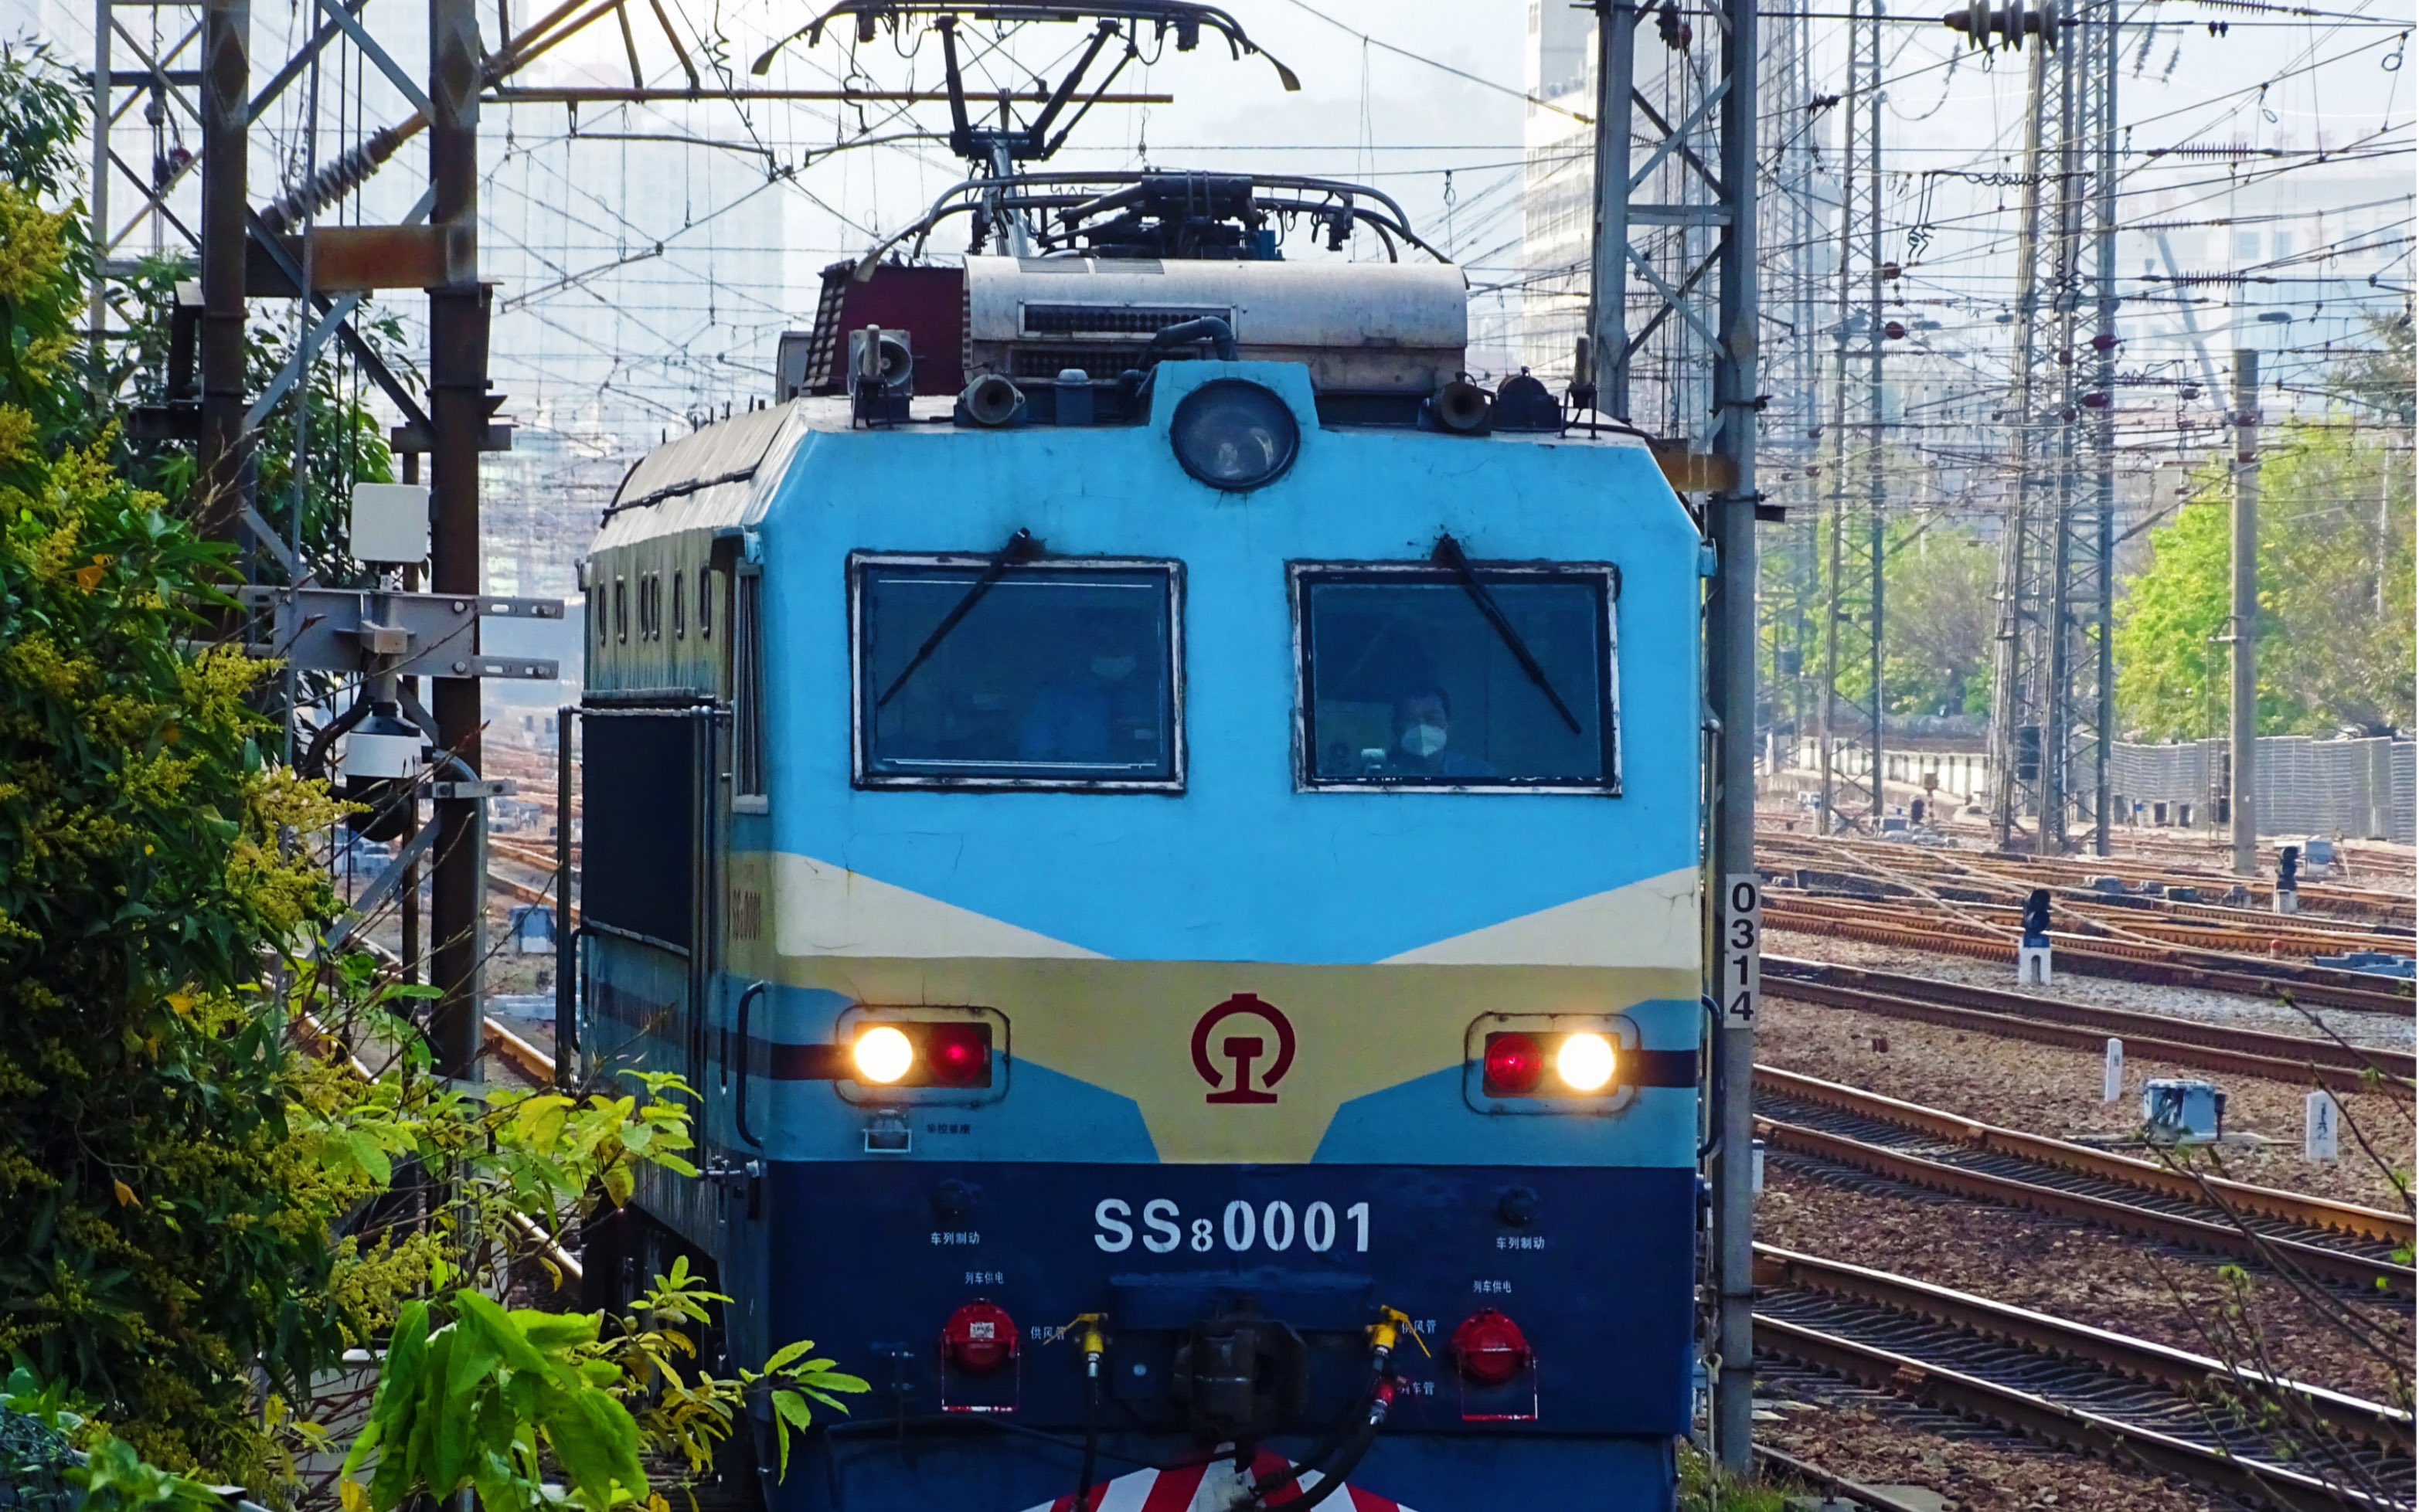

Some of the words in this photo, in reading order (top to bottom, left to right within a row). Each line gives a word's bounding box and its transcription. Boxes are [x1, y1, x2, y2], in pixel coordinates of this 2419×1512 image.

[1730, 882, 1757, 1021] 0314
[931, 1231, 980, 1245] 车列制动
[1496, 1236, 1545, 1250] 车列制动
[965, 1271, 1004, 1285] 列车供电
[1473, 1279, 1512, 1293] 列车供电
